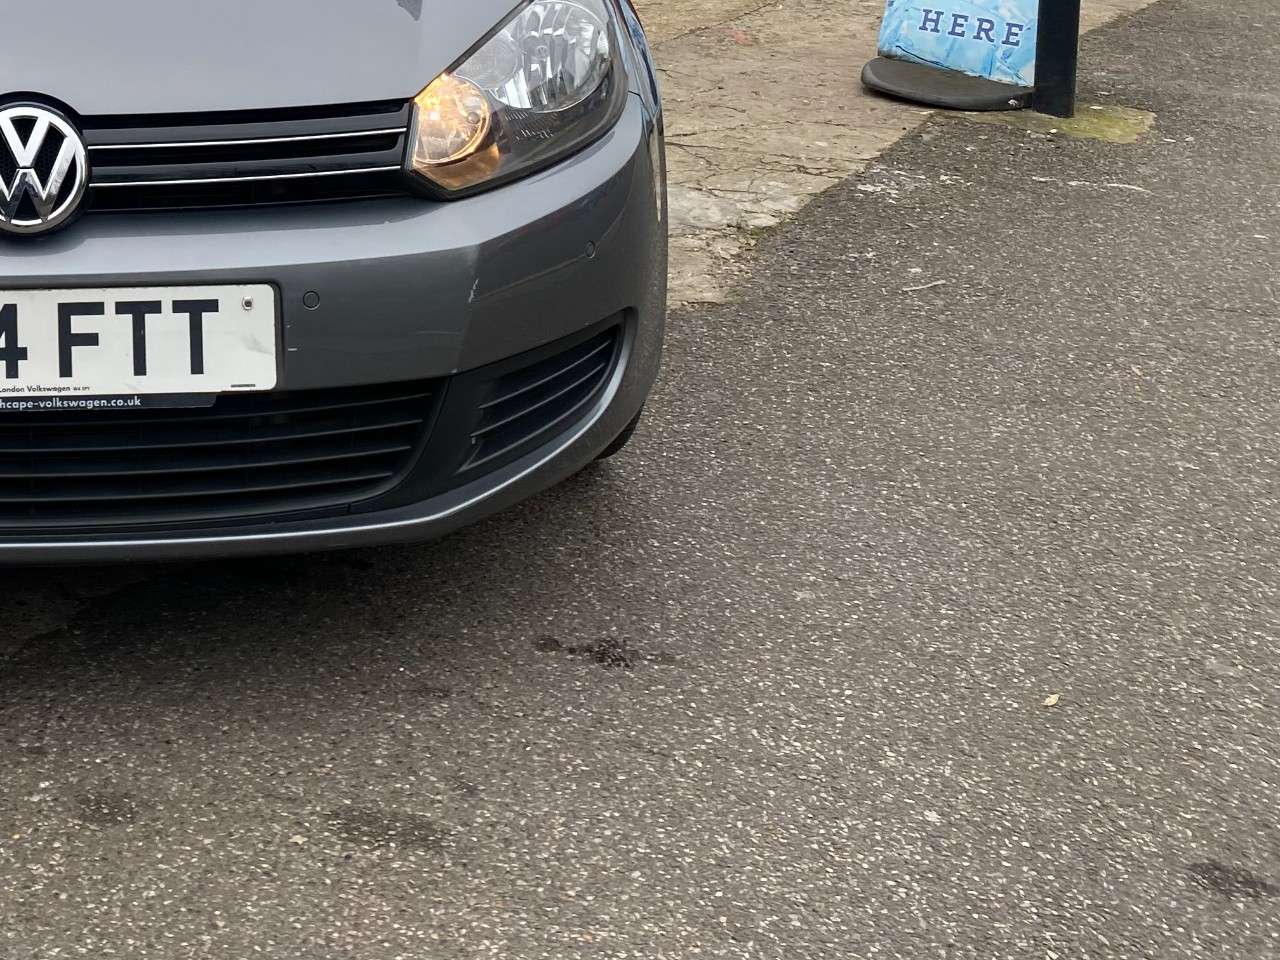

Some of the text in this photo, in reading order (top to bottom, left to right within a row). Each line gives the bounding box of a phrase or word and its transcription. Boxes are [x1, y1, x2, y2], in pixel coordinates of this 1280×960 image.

[919, 8, 1024, 47] HERE
[58, 298, 219, 377] FTT
[26, 385, 70, 393] Volkswagen
